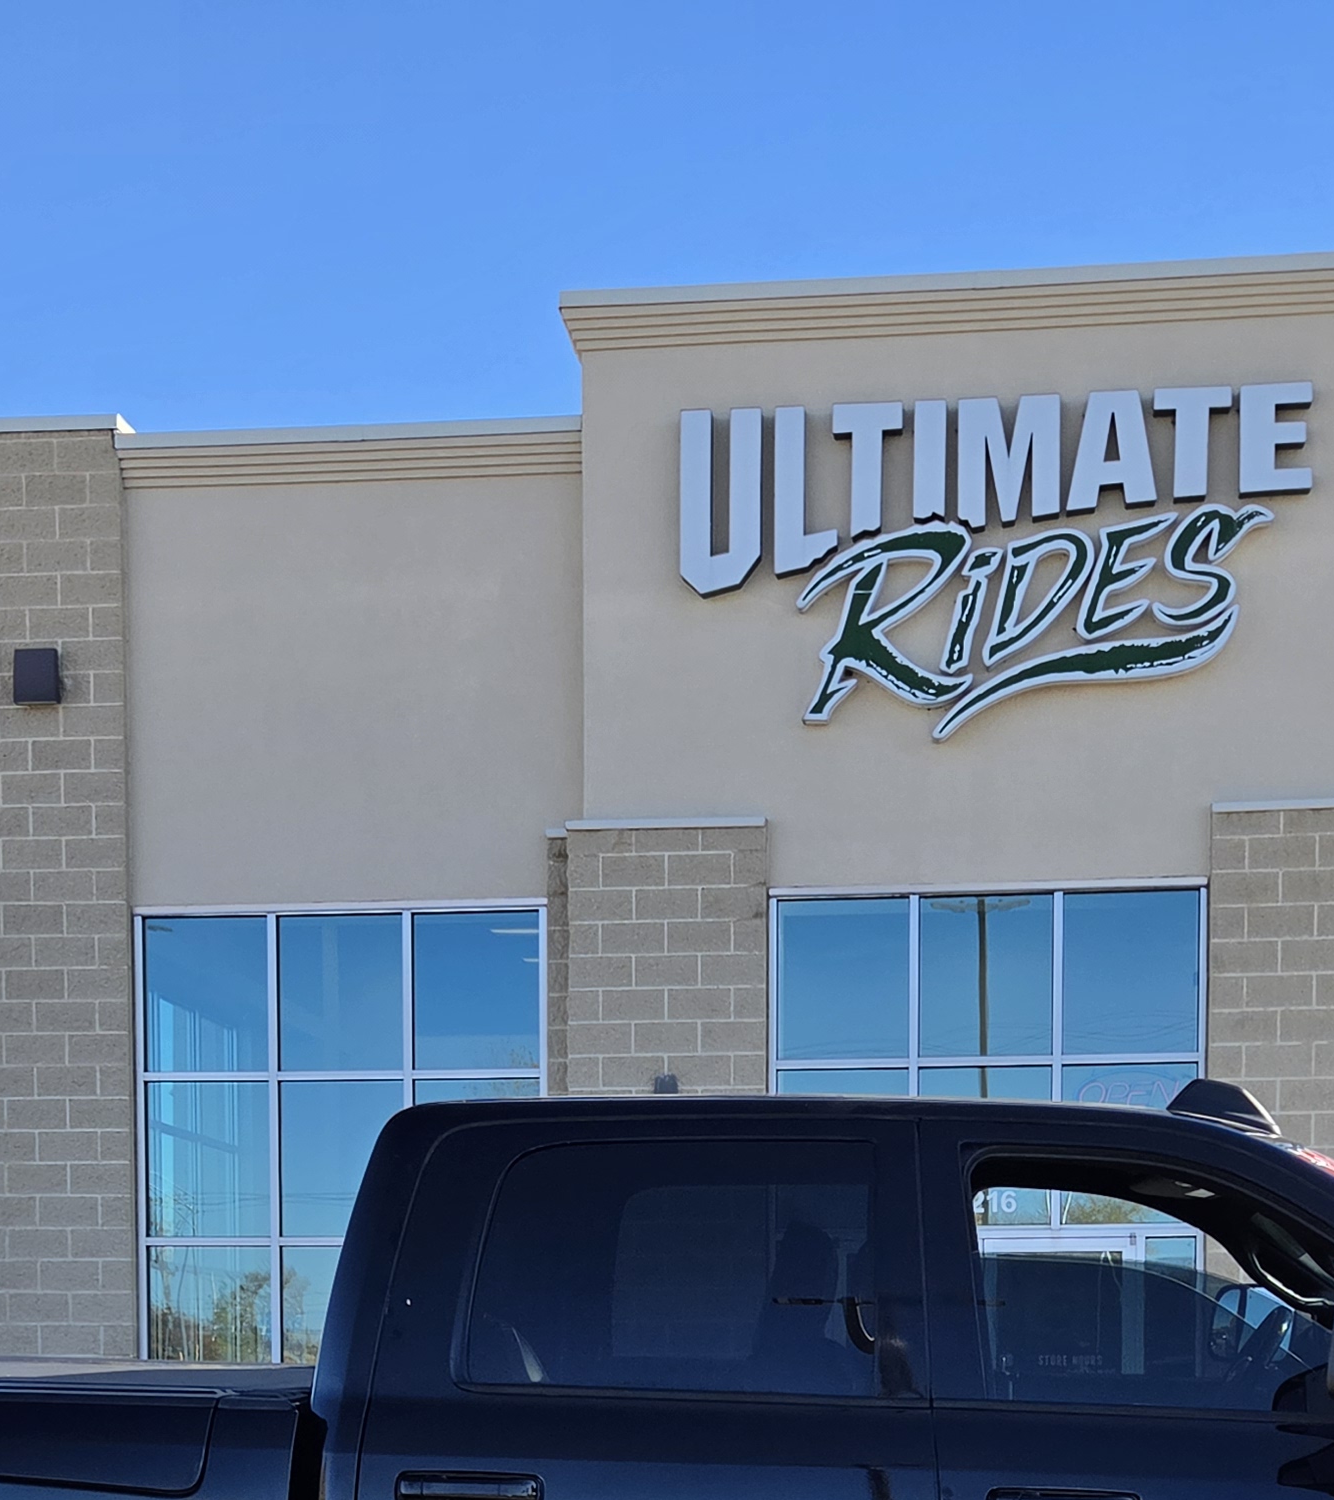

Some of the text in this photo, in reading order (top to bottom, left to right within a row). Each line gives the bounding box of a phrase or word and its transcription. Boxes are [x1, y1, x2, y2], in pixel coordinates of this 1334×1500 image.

[679, 381, 1314, 599] ULTIMATE
[1078, 1079, 1180, 1106] OPEN
[1037, 1354, 1068, 1367] STORE
